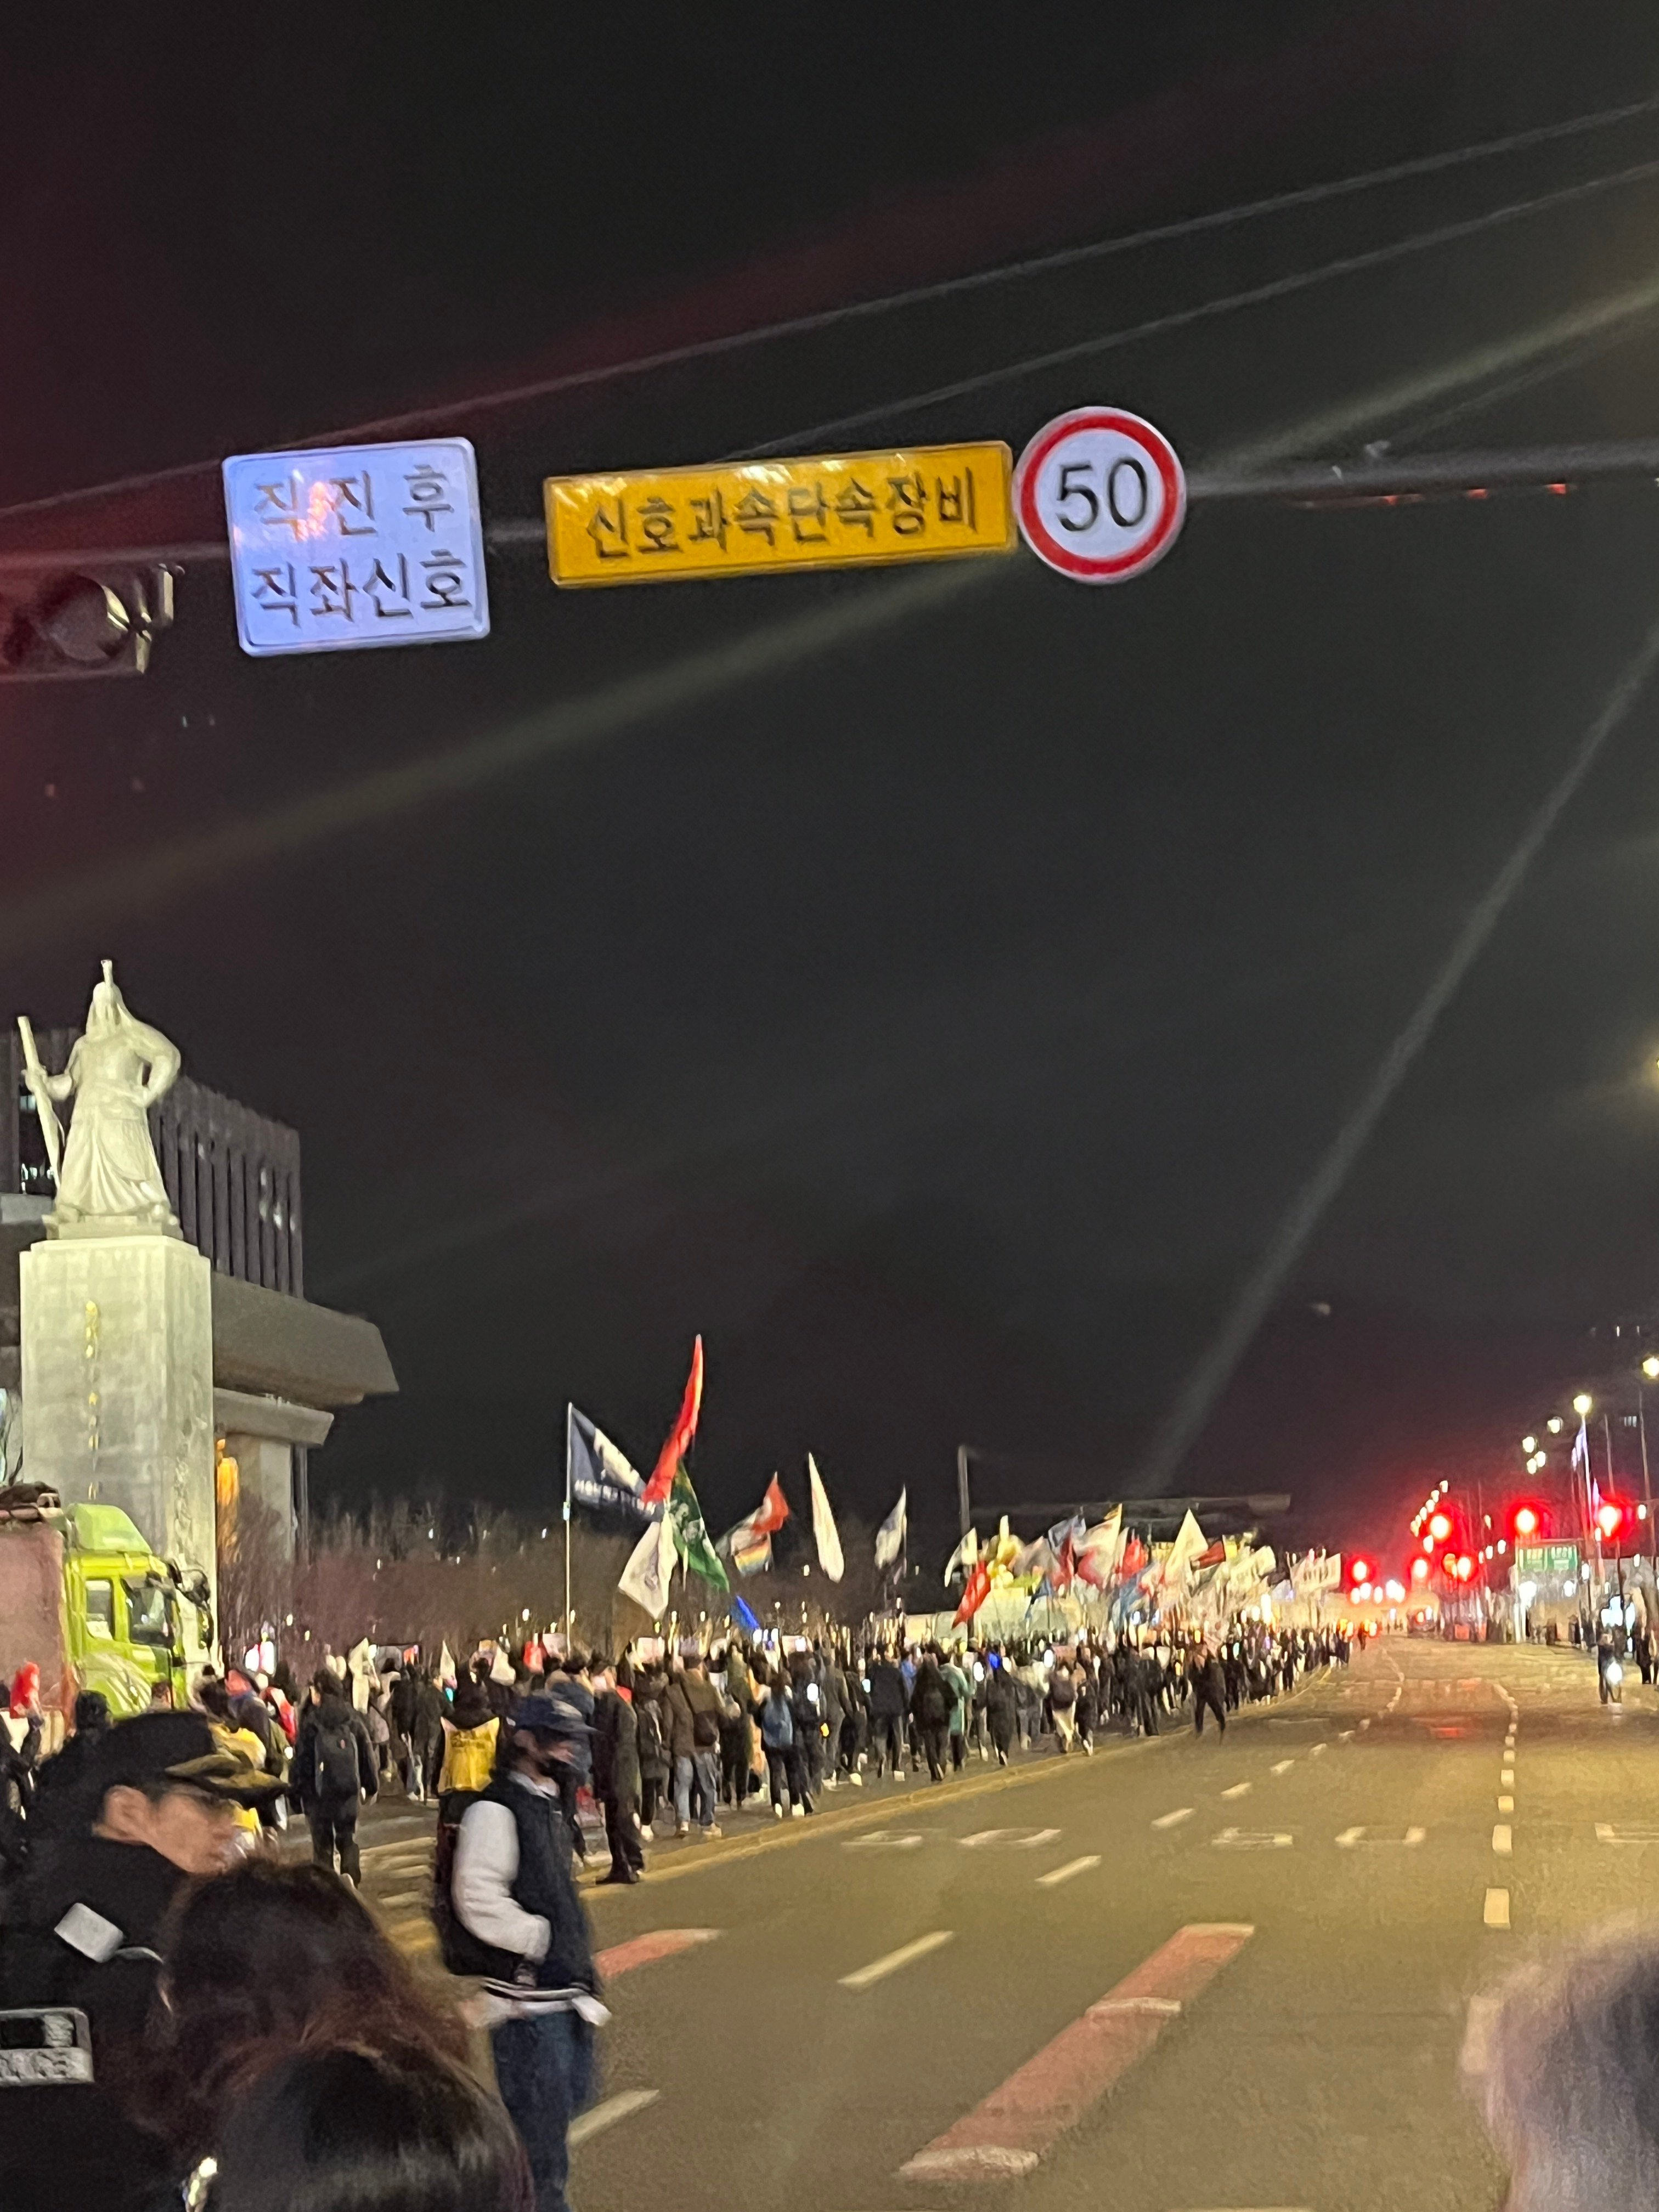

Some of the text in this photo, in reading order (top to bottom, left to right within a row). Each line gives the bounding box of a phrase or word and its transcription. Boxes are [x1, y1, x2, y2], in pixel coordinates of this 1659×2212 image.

[402, 464, 455, 532] 후
[586, 466, 977, 560] 신호과속단속장비
[1056, 456, 1147, 531] 50
[251, 549, 472, 628] 직좌신호
